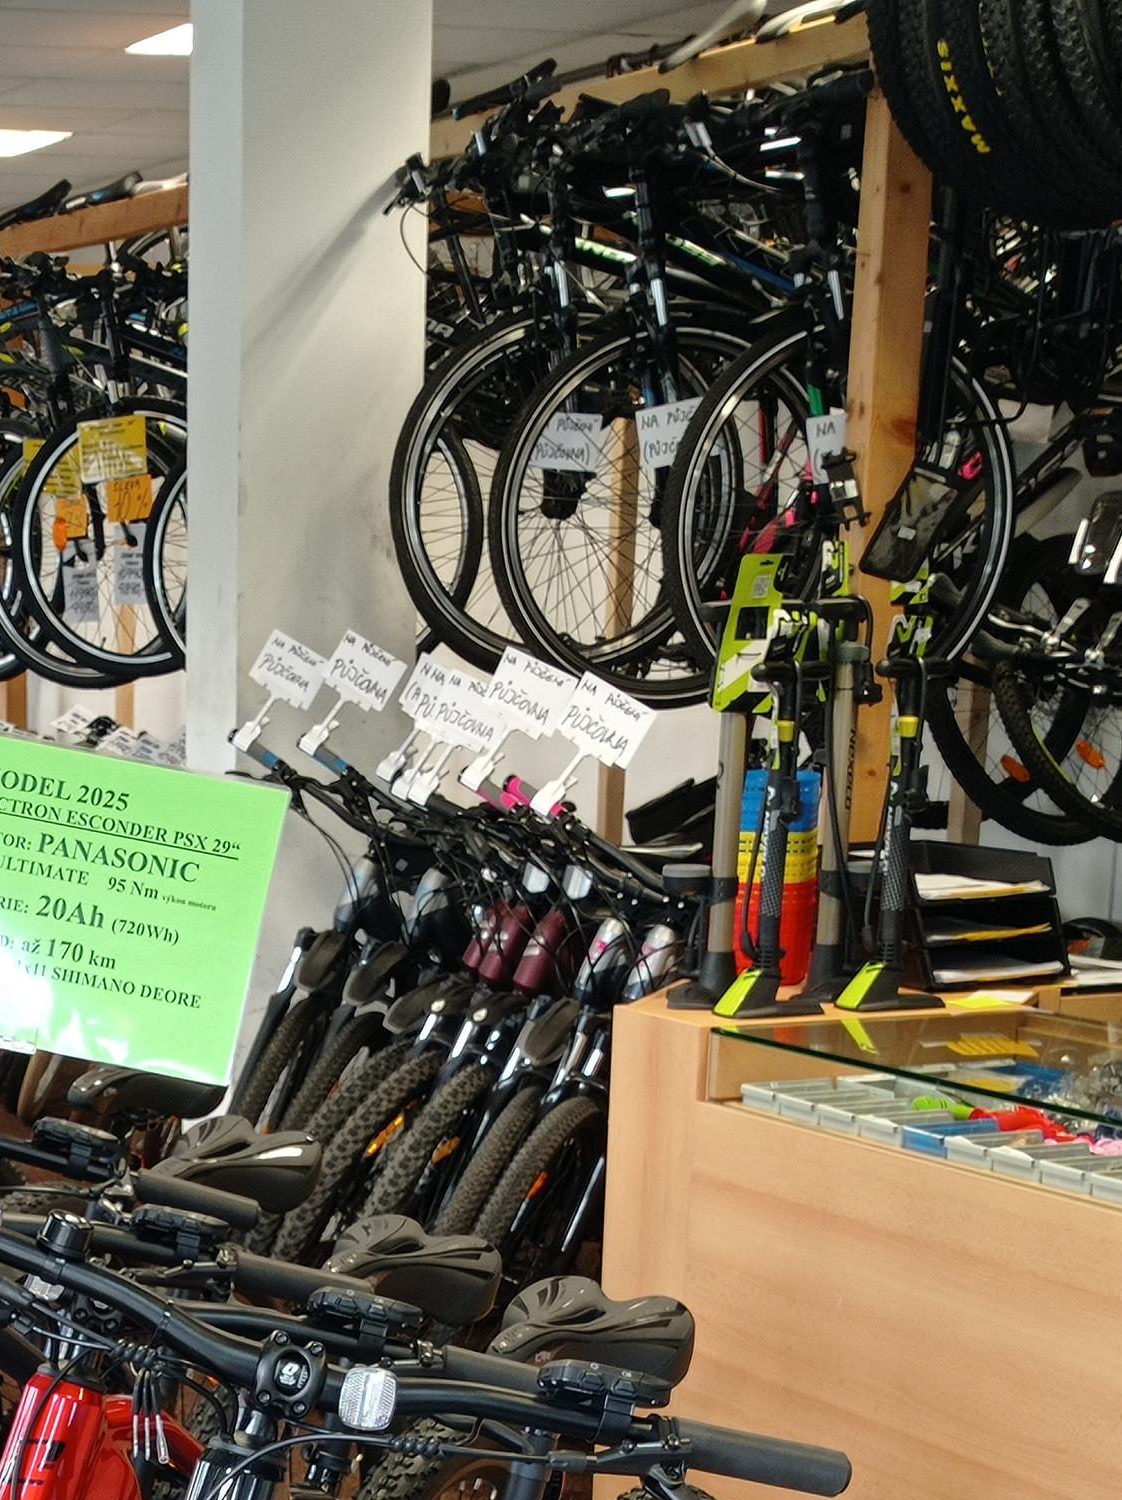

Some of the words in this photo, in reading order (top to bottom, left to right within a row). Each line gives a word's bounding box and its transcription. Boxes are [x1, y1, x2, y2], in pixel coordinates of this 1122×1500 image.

[78, 785, 130, 811] 2025
[66, 810, 167, 842] ESCONDER
[173, 831, 208, 850] PSX
[37, 833, 200, 883] PANASONIC
[108, 877, 126, 893] 95
[129, 880, 159, 900] Nm
[36, 895, 105, 929] 20Ah
[111, 918, 179, 946] (720Wh)
[48, 938, 84, 962] 170
[89, 950, 116, 970] km
[51, 967, 135, 996] SHIMANO
[139, 984, 201, 1009] DEORE
